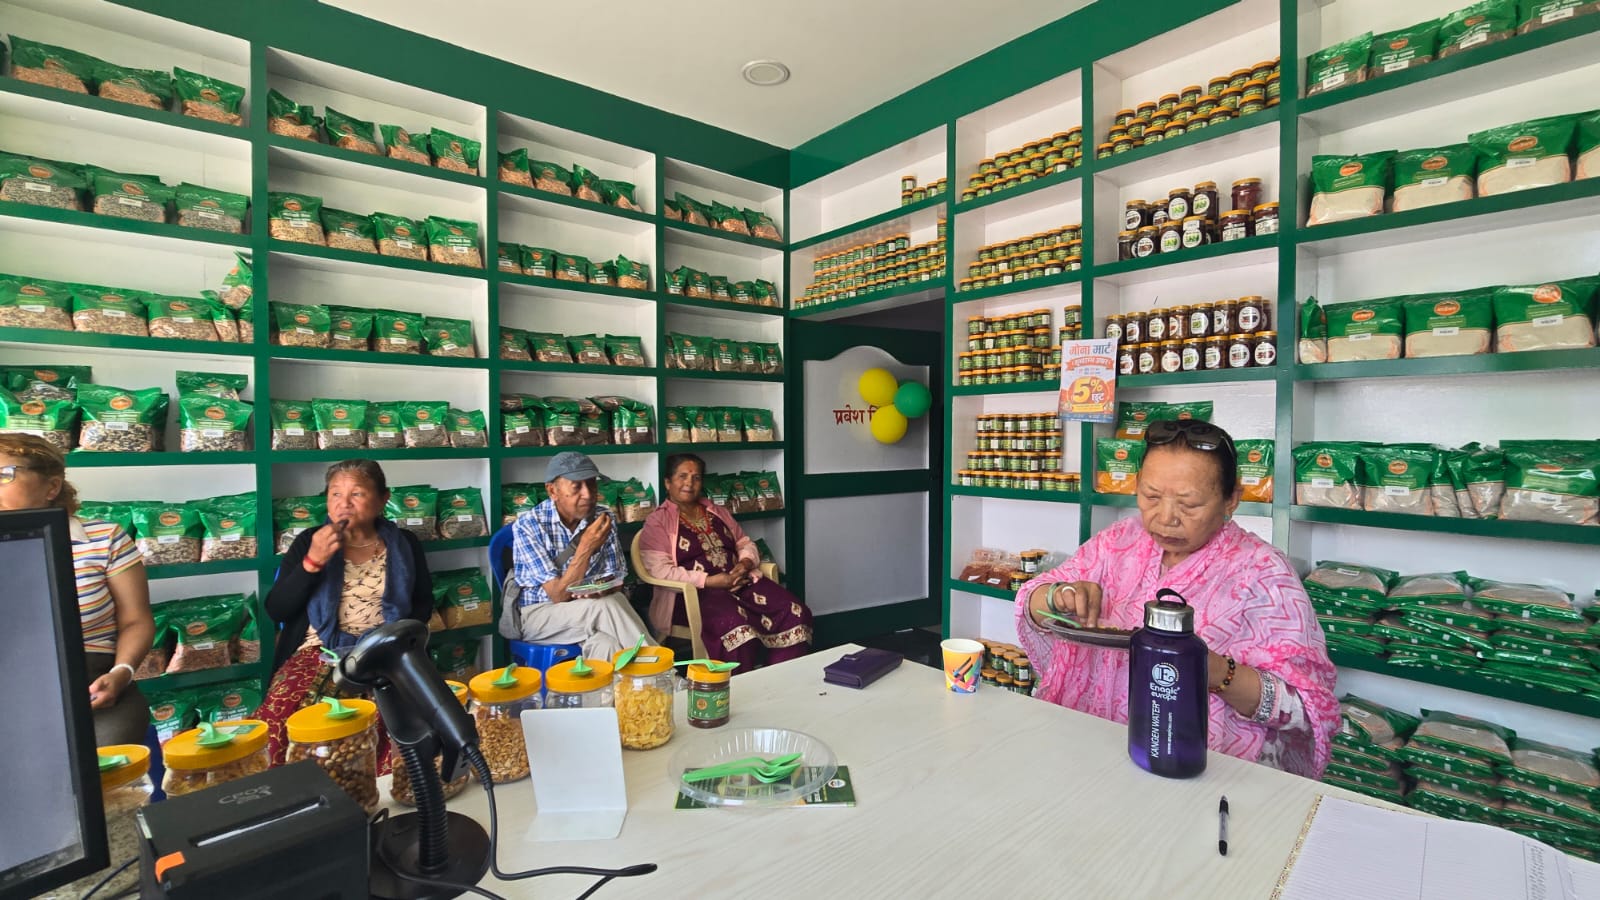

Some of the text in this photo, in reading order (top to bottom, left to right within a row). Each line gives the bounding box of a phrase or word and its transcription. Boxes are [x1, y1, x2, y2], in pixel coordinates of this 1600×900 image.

[1093, 342, 1111, 354] मार्ट
[1072, 377, 1103, 403] 5%
[832, 404, 865, 425] प्रवेश
[1149, 682, 1179, 696] Enagic
[1151, 691, 1177, 702] europe
[1151, 728, 1160, 757] KANGEN
